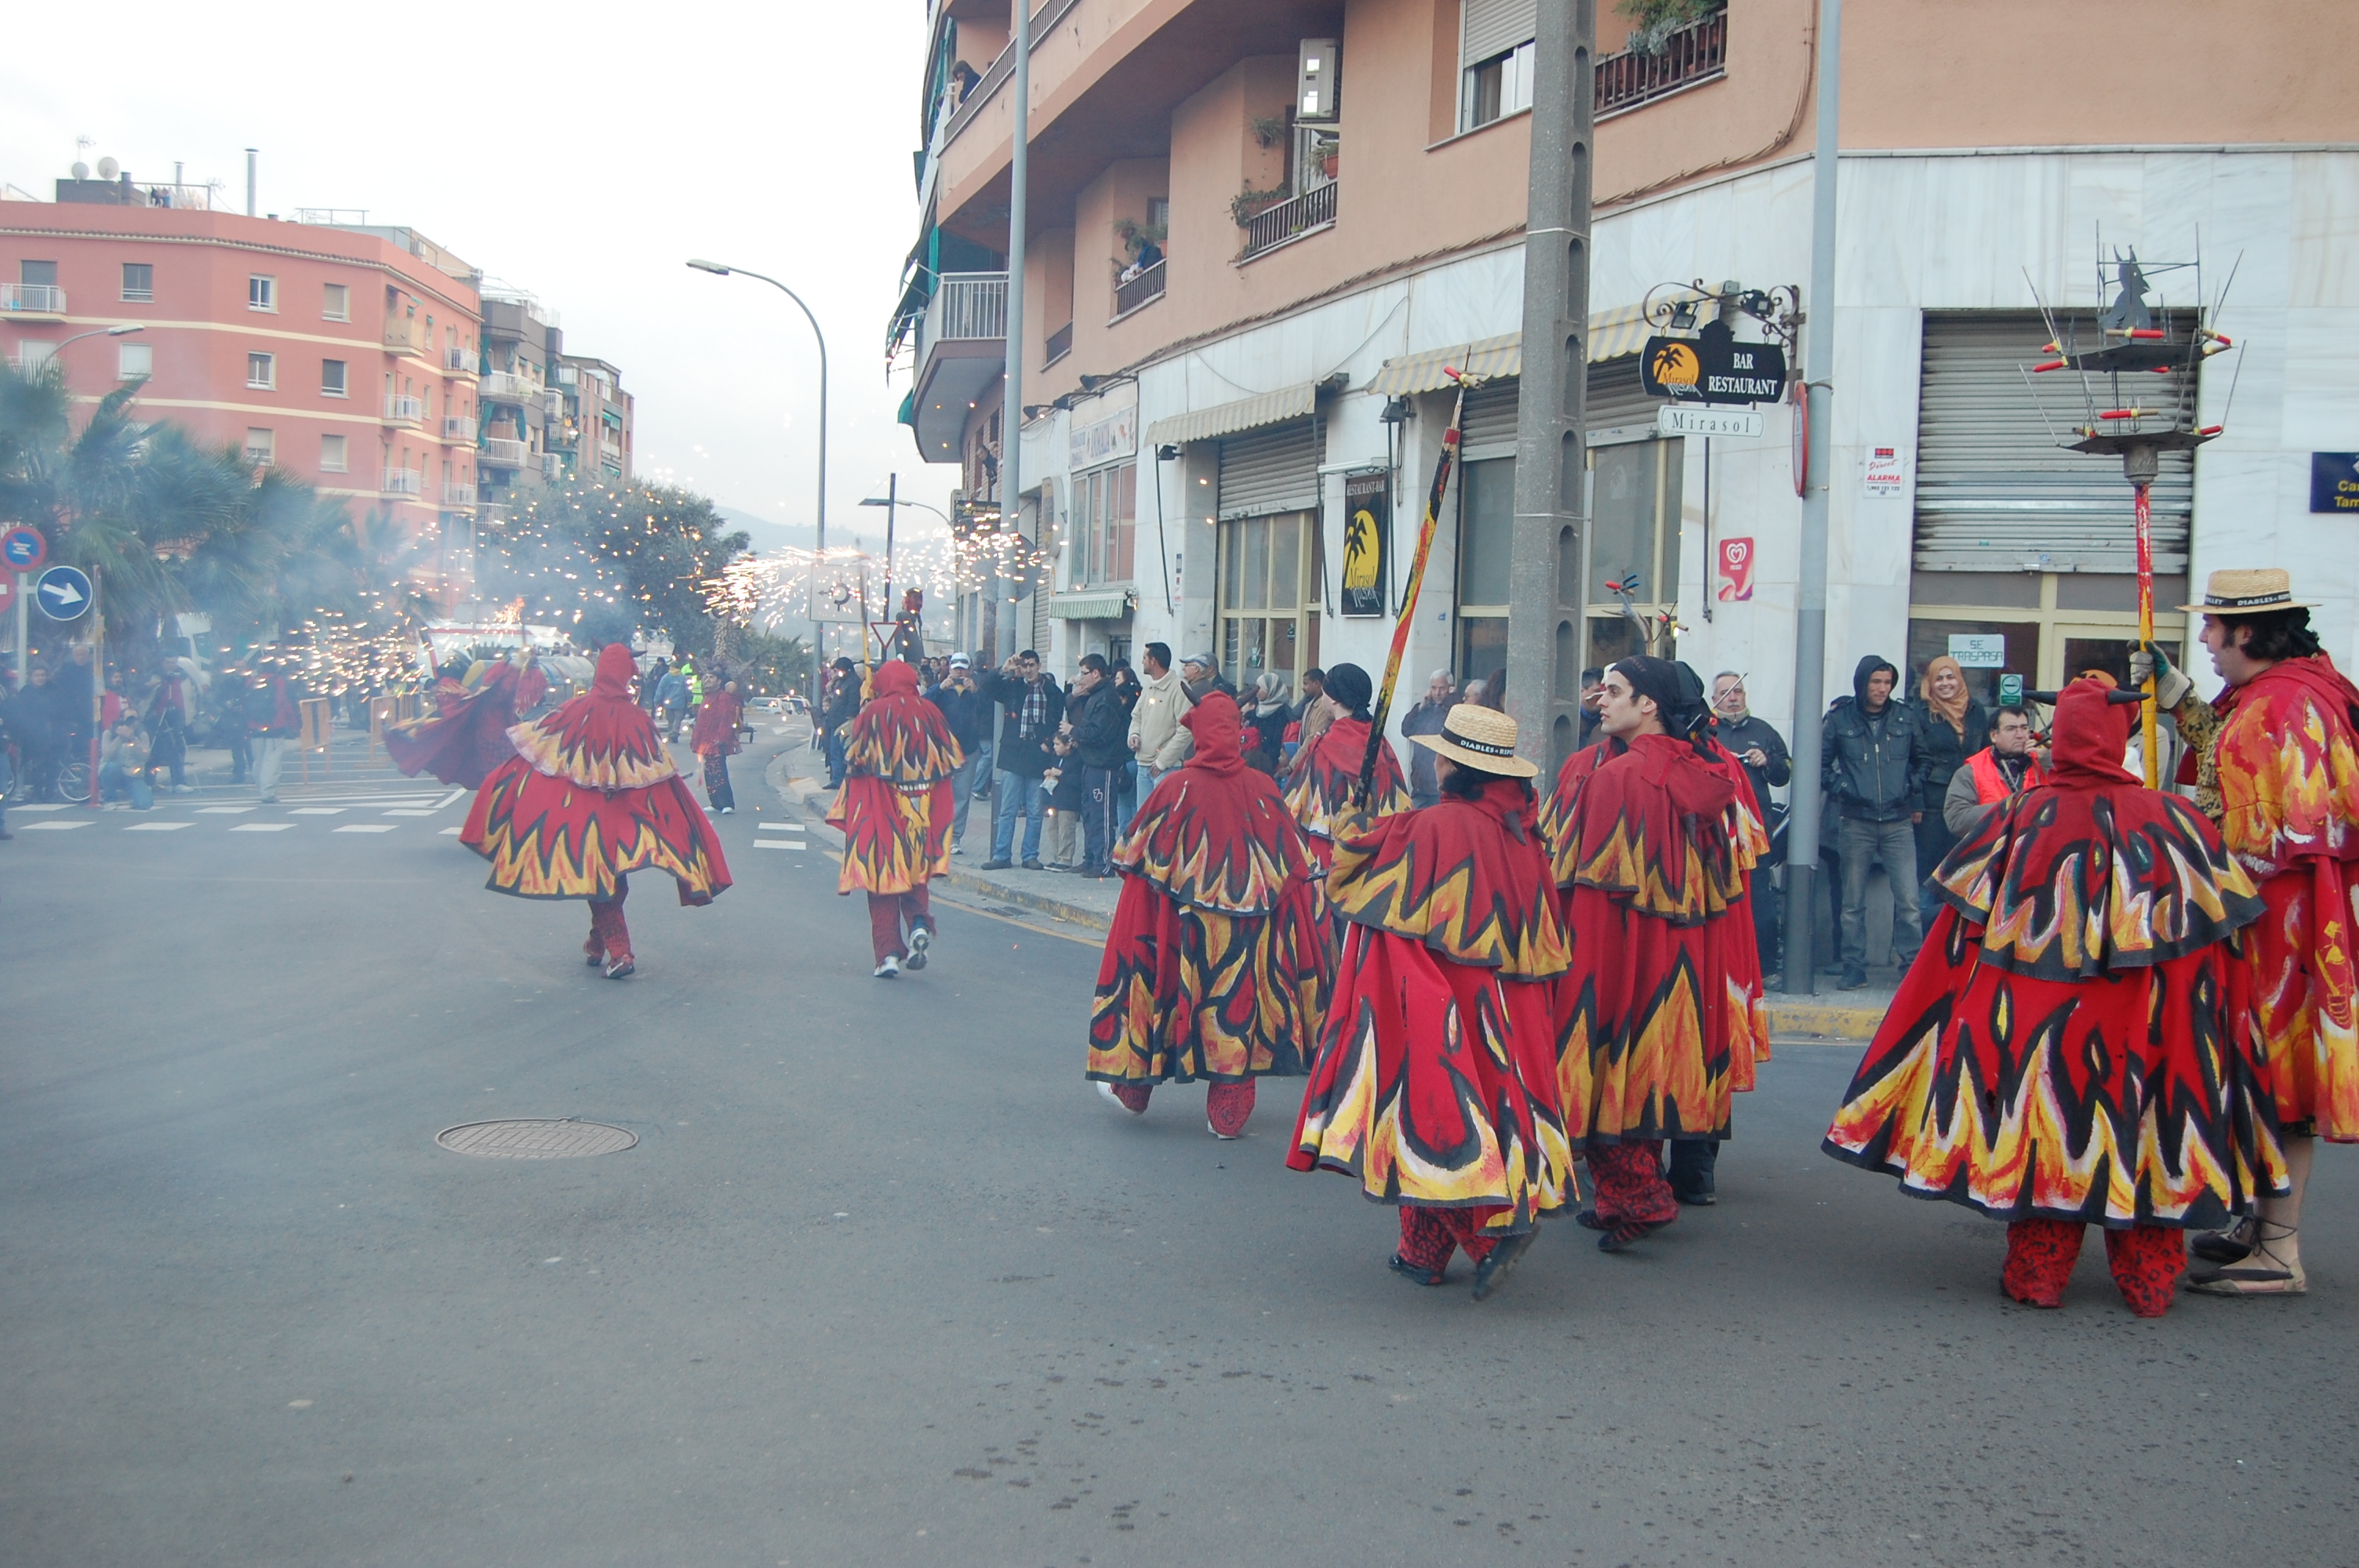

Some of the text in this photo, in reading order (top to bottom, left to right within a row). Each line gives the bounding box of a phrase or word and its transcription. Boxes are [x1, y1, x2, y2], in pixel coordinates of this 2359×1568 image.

[1733, 353, 1754, 369] BAR
[1663, 372, 1694, 384] Mirasol
[1708, 376, 1777, 395] RESTAURANT
[1672, 412, 1750, 433] Mirasol
[1350, 566, 1375, 588] Mirasol
[2237, 597, 2273, 606] DIABLES
[1969, 640, 1983, 650] SE
[1950, 651, 2003, 662] TRASPASA
[1460, 739, 1494, 753] DIABLES
